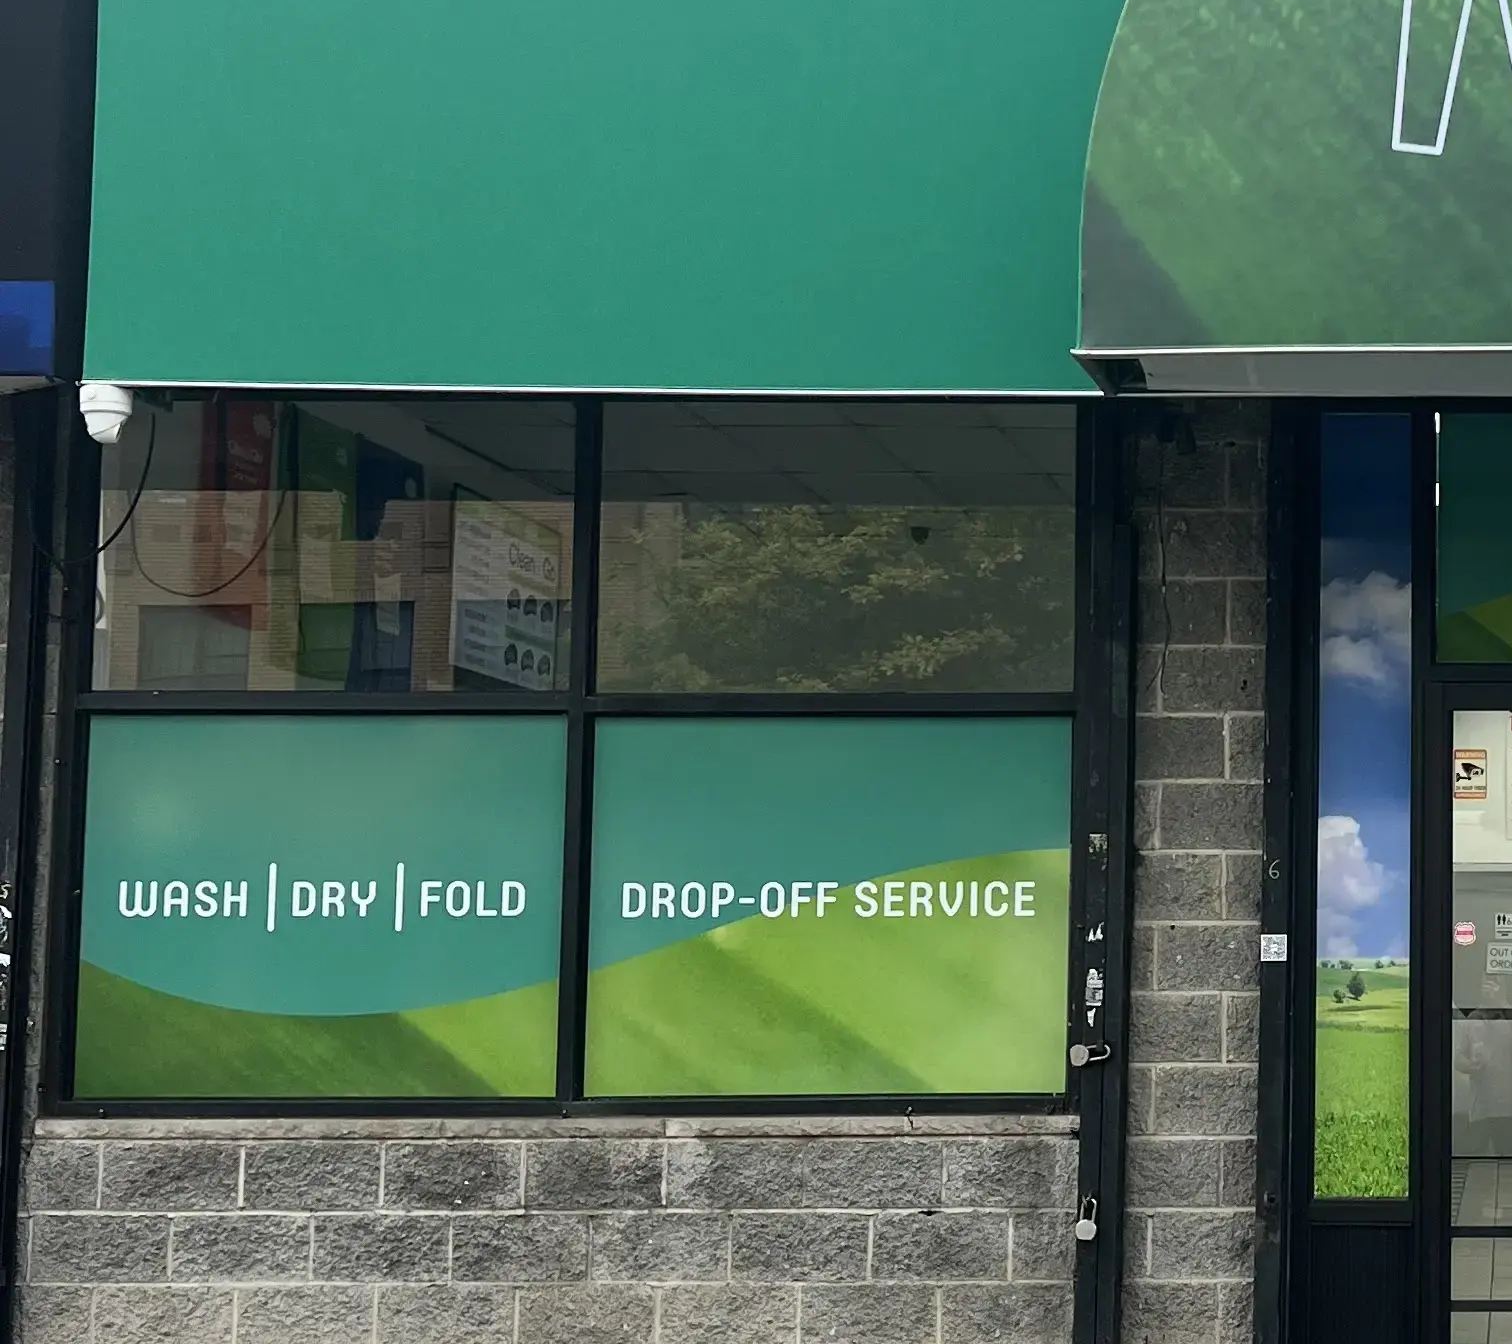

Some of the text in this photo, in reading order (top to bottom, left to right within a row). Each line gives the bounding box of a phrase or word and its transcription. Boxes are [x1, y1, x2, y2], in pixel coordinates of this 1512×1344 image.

[120, 881, 526, 917] WASH DRY FOLD
[621, 881, 1037, 919] DROP-OFF SERVICE
[1489, 947, 1508, 957] OUT
